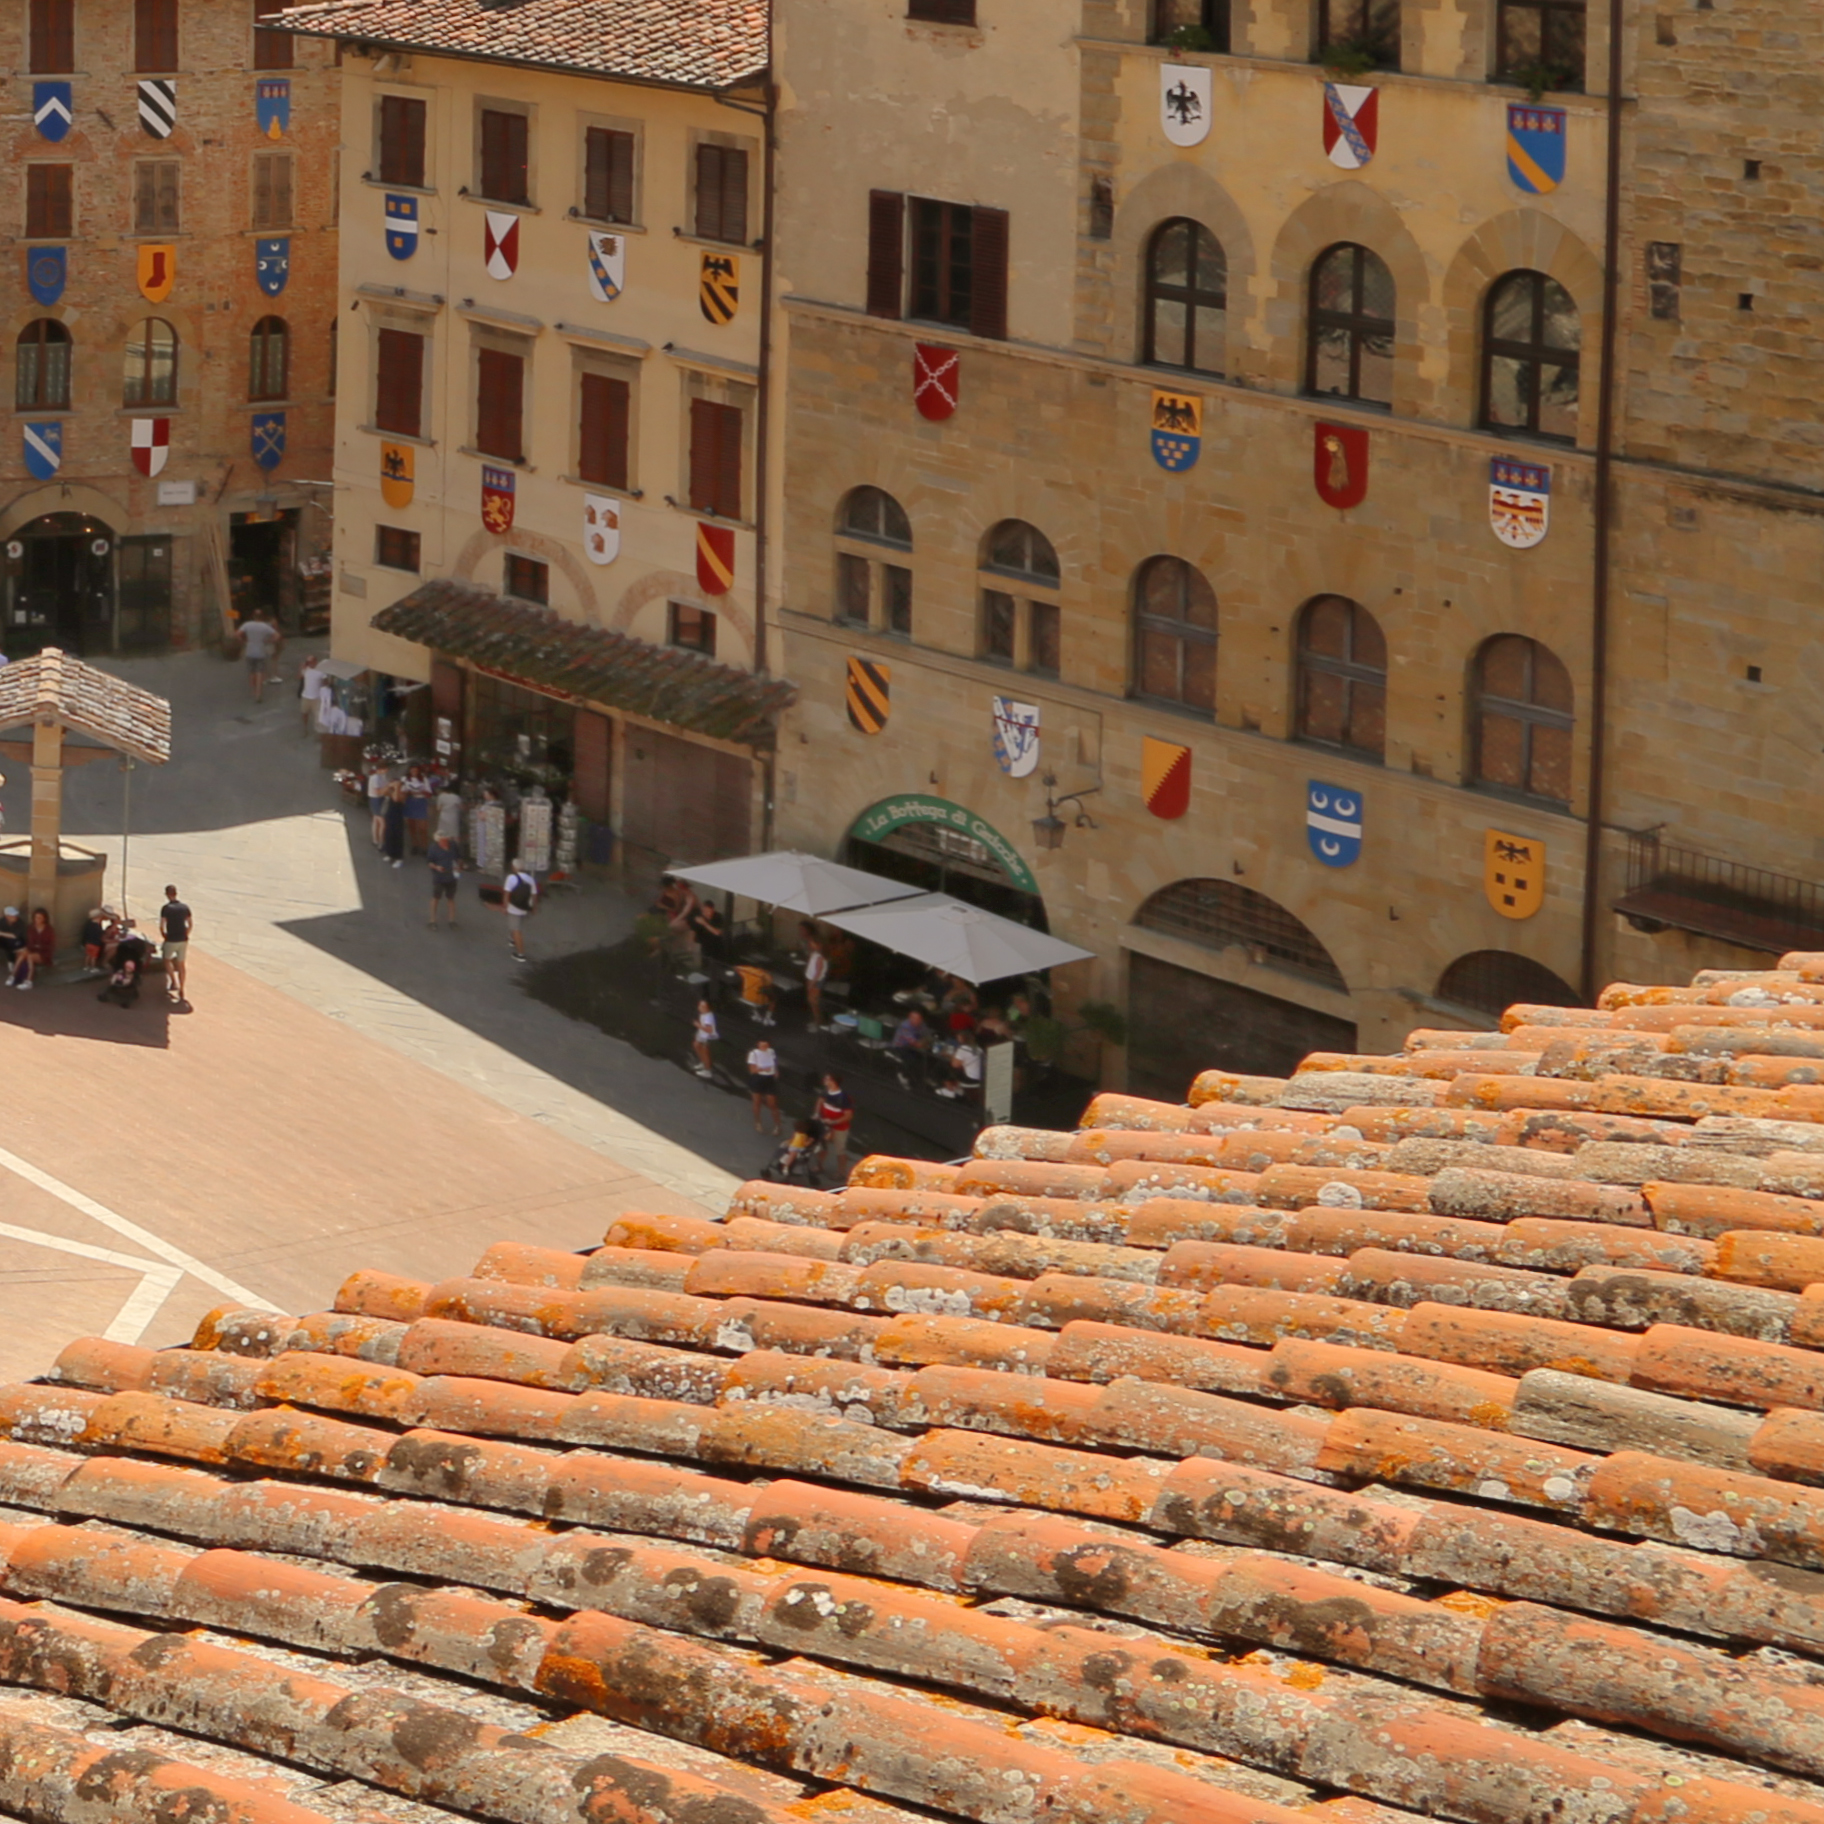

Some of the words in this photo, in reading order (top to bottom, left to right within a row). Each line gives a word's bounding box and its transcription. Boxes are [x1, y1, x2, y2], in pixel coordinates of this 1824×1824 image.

[867, 814, 890, 831] La
[887, 801, 947, 820] Bottega
[951, 810, 968, 827] di
